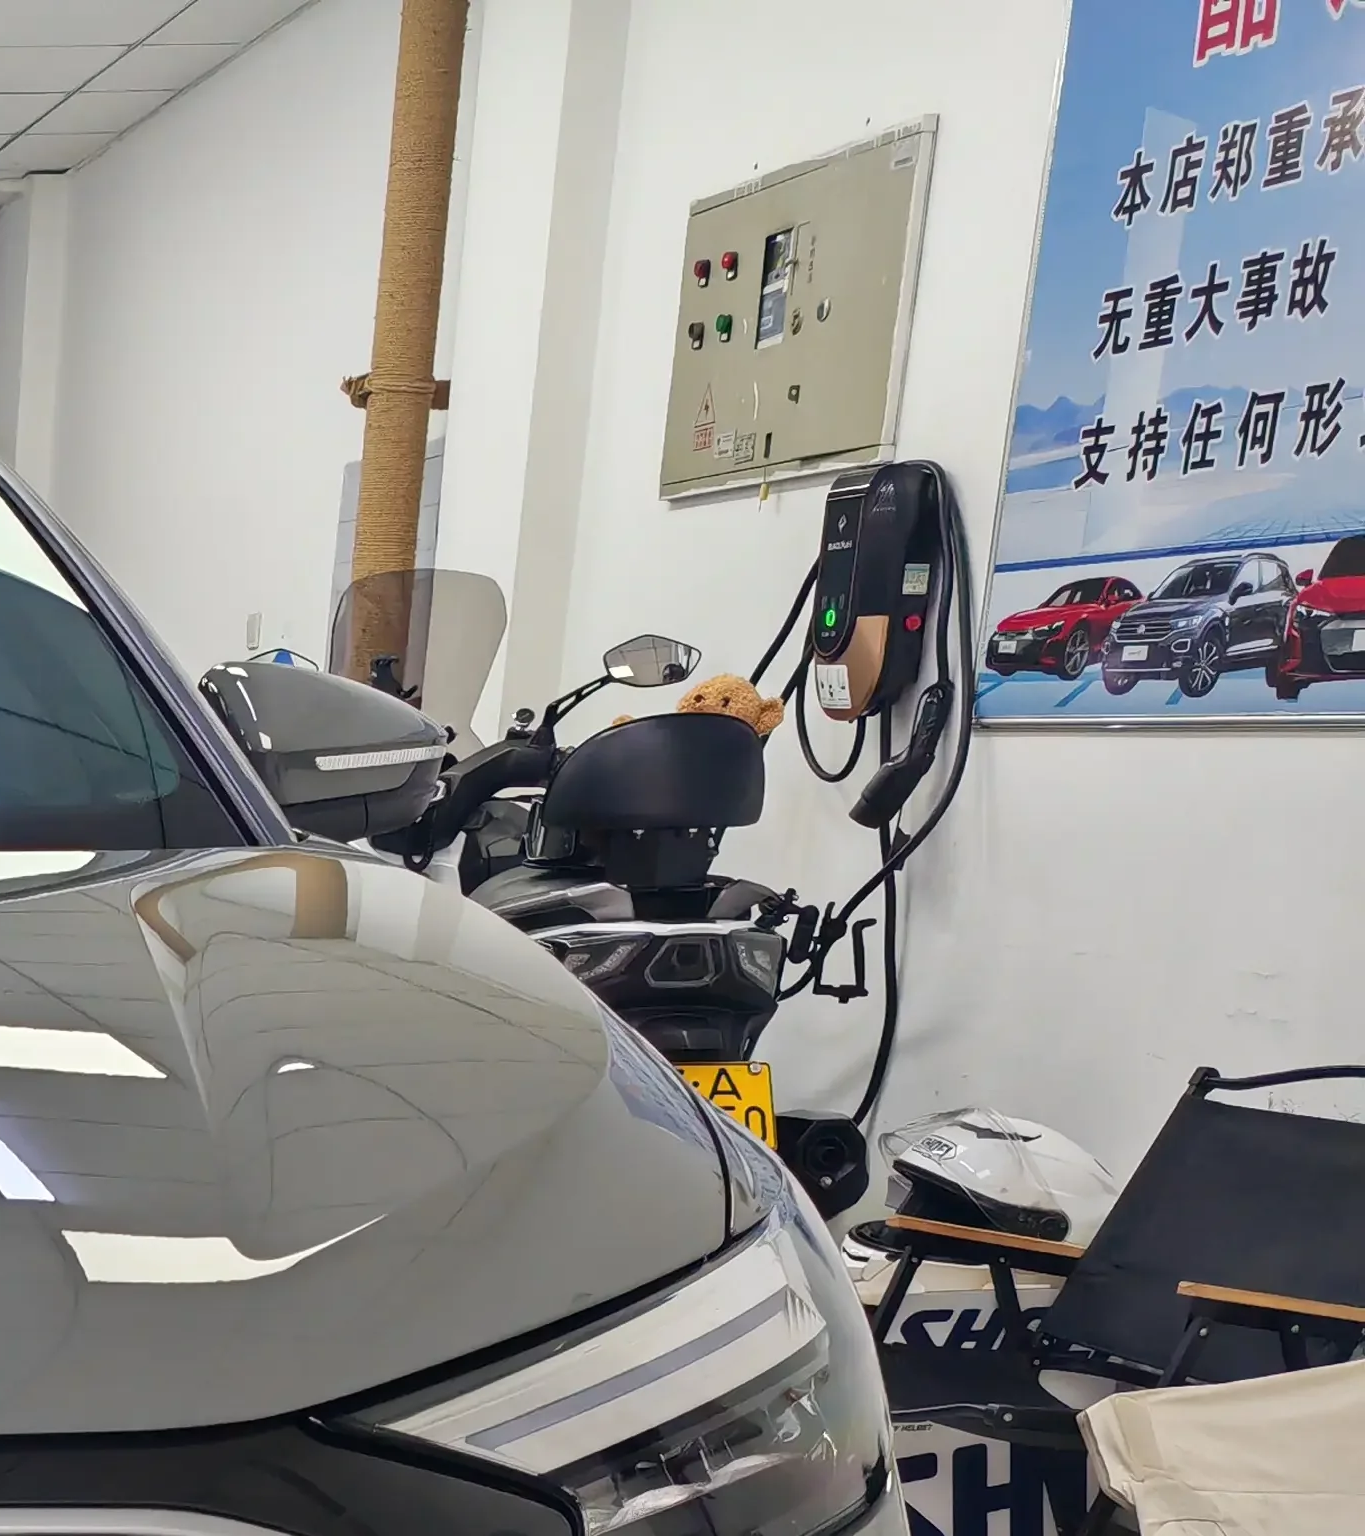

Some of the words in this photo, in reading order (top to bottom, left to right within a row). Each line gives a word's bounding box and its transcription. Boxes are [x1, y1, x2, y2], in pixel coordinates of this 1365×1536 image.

[1092, 236, 1338, 363] 无重大事故
[1072, 376, 1365, 490] 支持任何形
